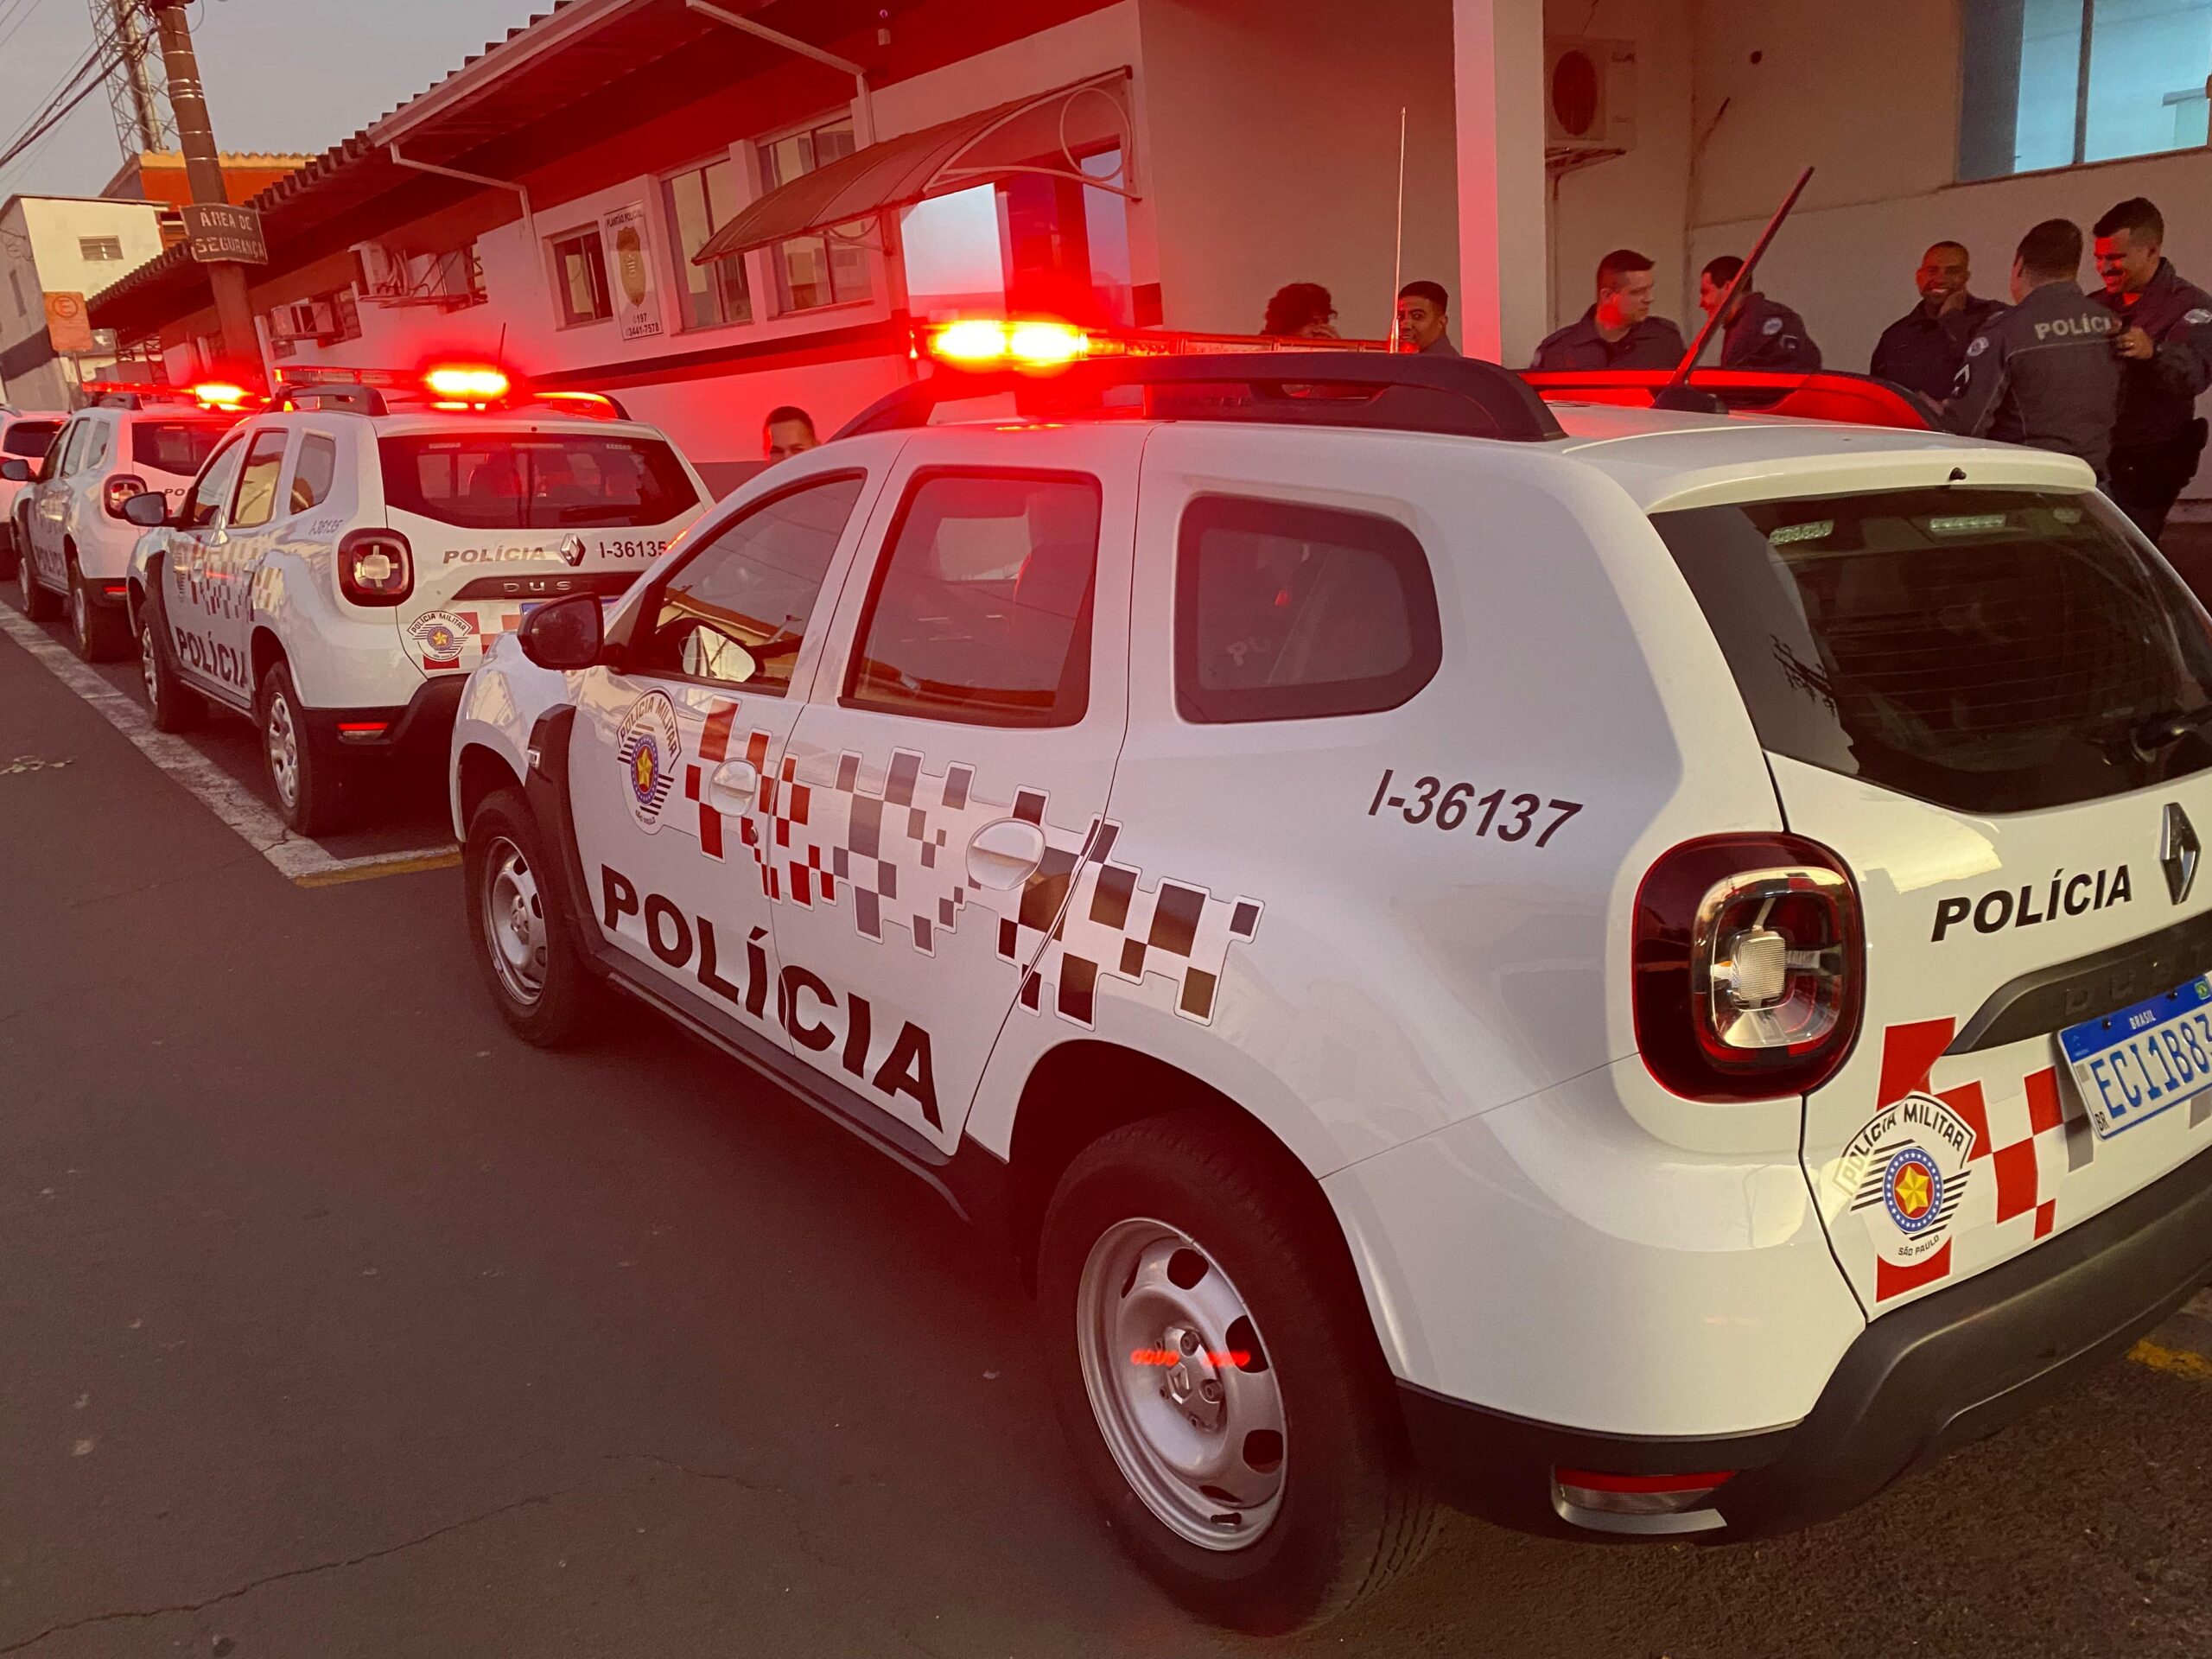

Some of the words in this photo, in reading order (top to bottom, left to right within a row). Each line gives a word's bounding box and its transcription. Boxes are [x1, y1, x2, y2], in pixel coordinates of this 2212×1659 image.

[2034, 313, 2111, 340] POLÍCI
[443, 545, 545, 564] POLÍCIA
[600, 541, 667, 558] I-36135
[439, 612, 467, 632] MILITAR
[620, 696, 654, 742] POLÍCIA
[655, 698, 677, 757] MILITAR
[1368, 769, 1584, 848] I-36137
[1930, 865, 2133, 942] POLÍCIA
[601, 864, 944, 1134] POLÍCIA
[2129, 1009, 2157, 1030] BRASIL
[2094, 1111, 2110, 1131] BR
[1842, 1112, 1897, 1182] POLÍCIA
[1904, 1103, 1965, 1152] MILITAR
[1898, 1247, 1913, 1256] SÃO
[1915, 1235, 1940, 1255] PAULO
